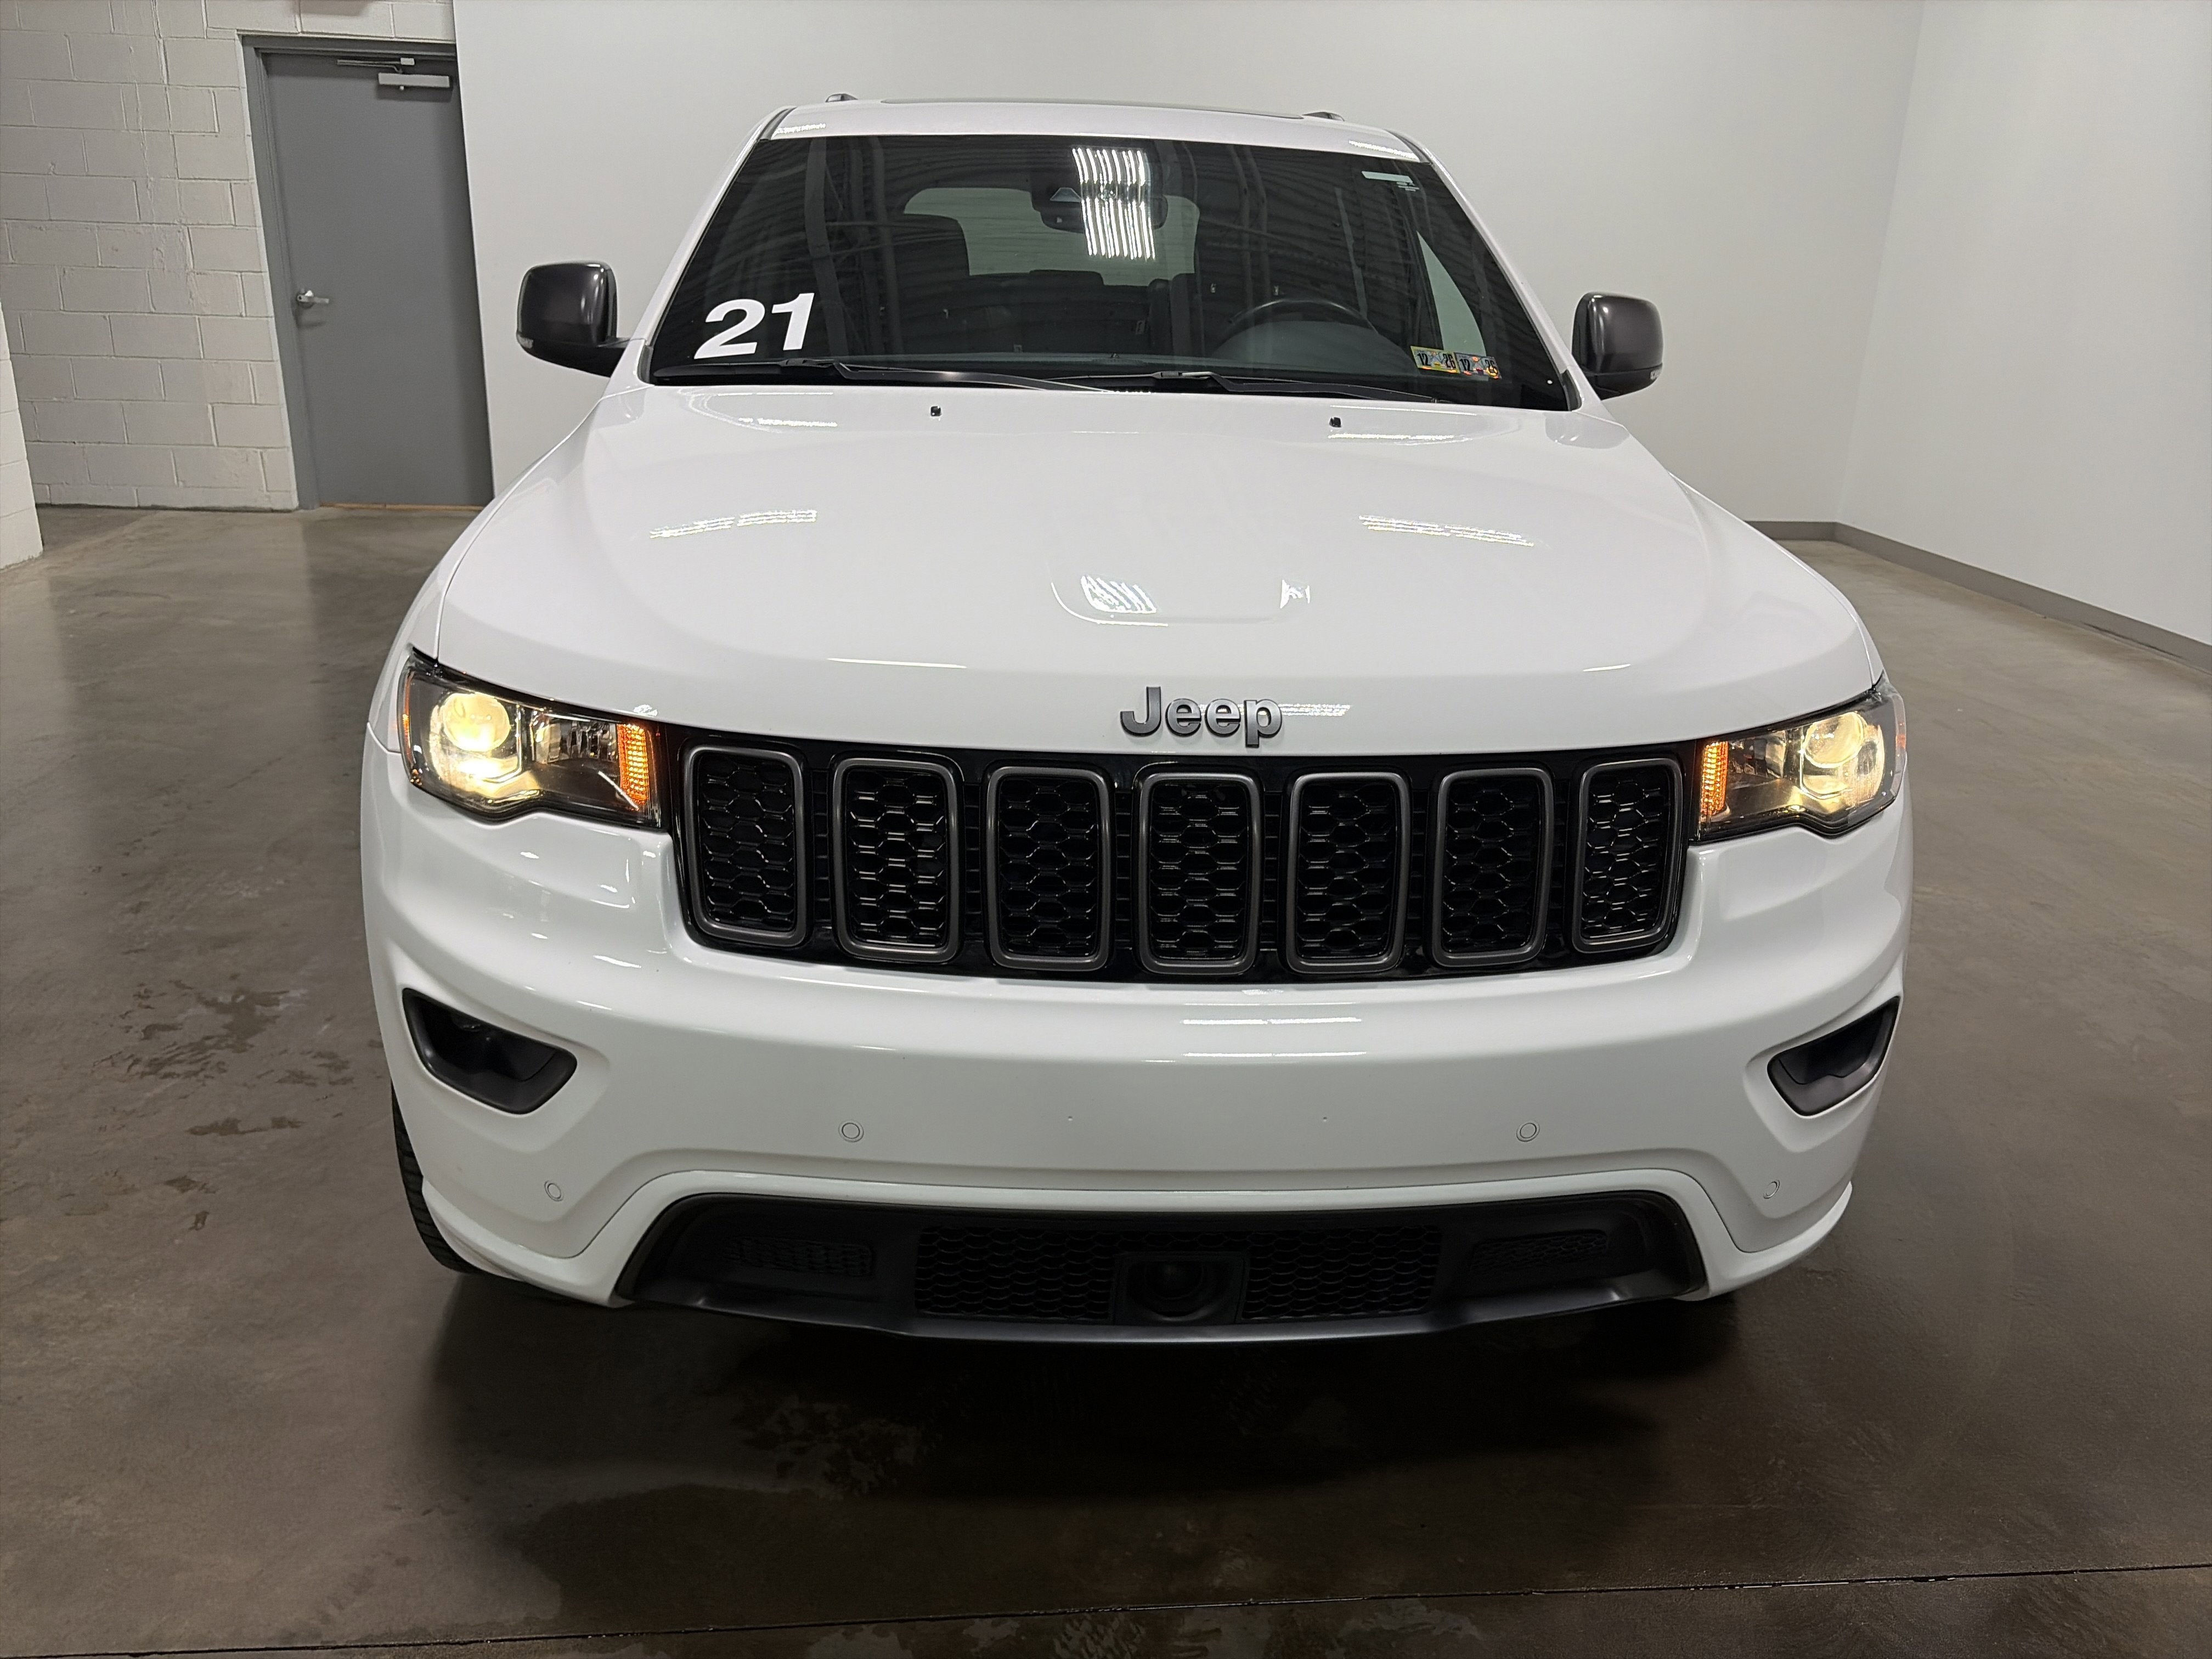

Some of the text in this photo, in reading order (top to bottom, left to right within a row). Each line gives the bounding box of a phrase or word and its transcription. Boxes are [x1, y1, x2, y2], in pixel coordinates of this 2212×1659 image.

[693, 292, 815, 359] 21
[1417, 353, 1457, 369] 12 26
[1459, 358, 1474, 372] 12
[1120, 686, 1283, 748] Jeep
